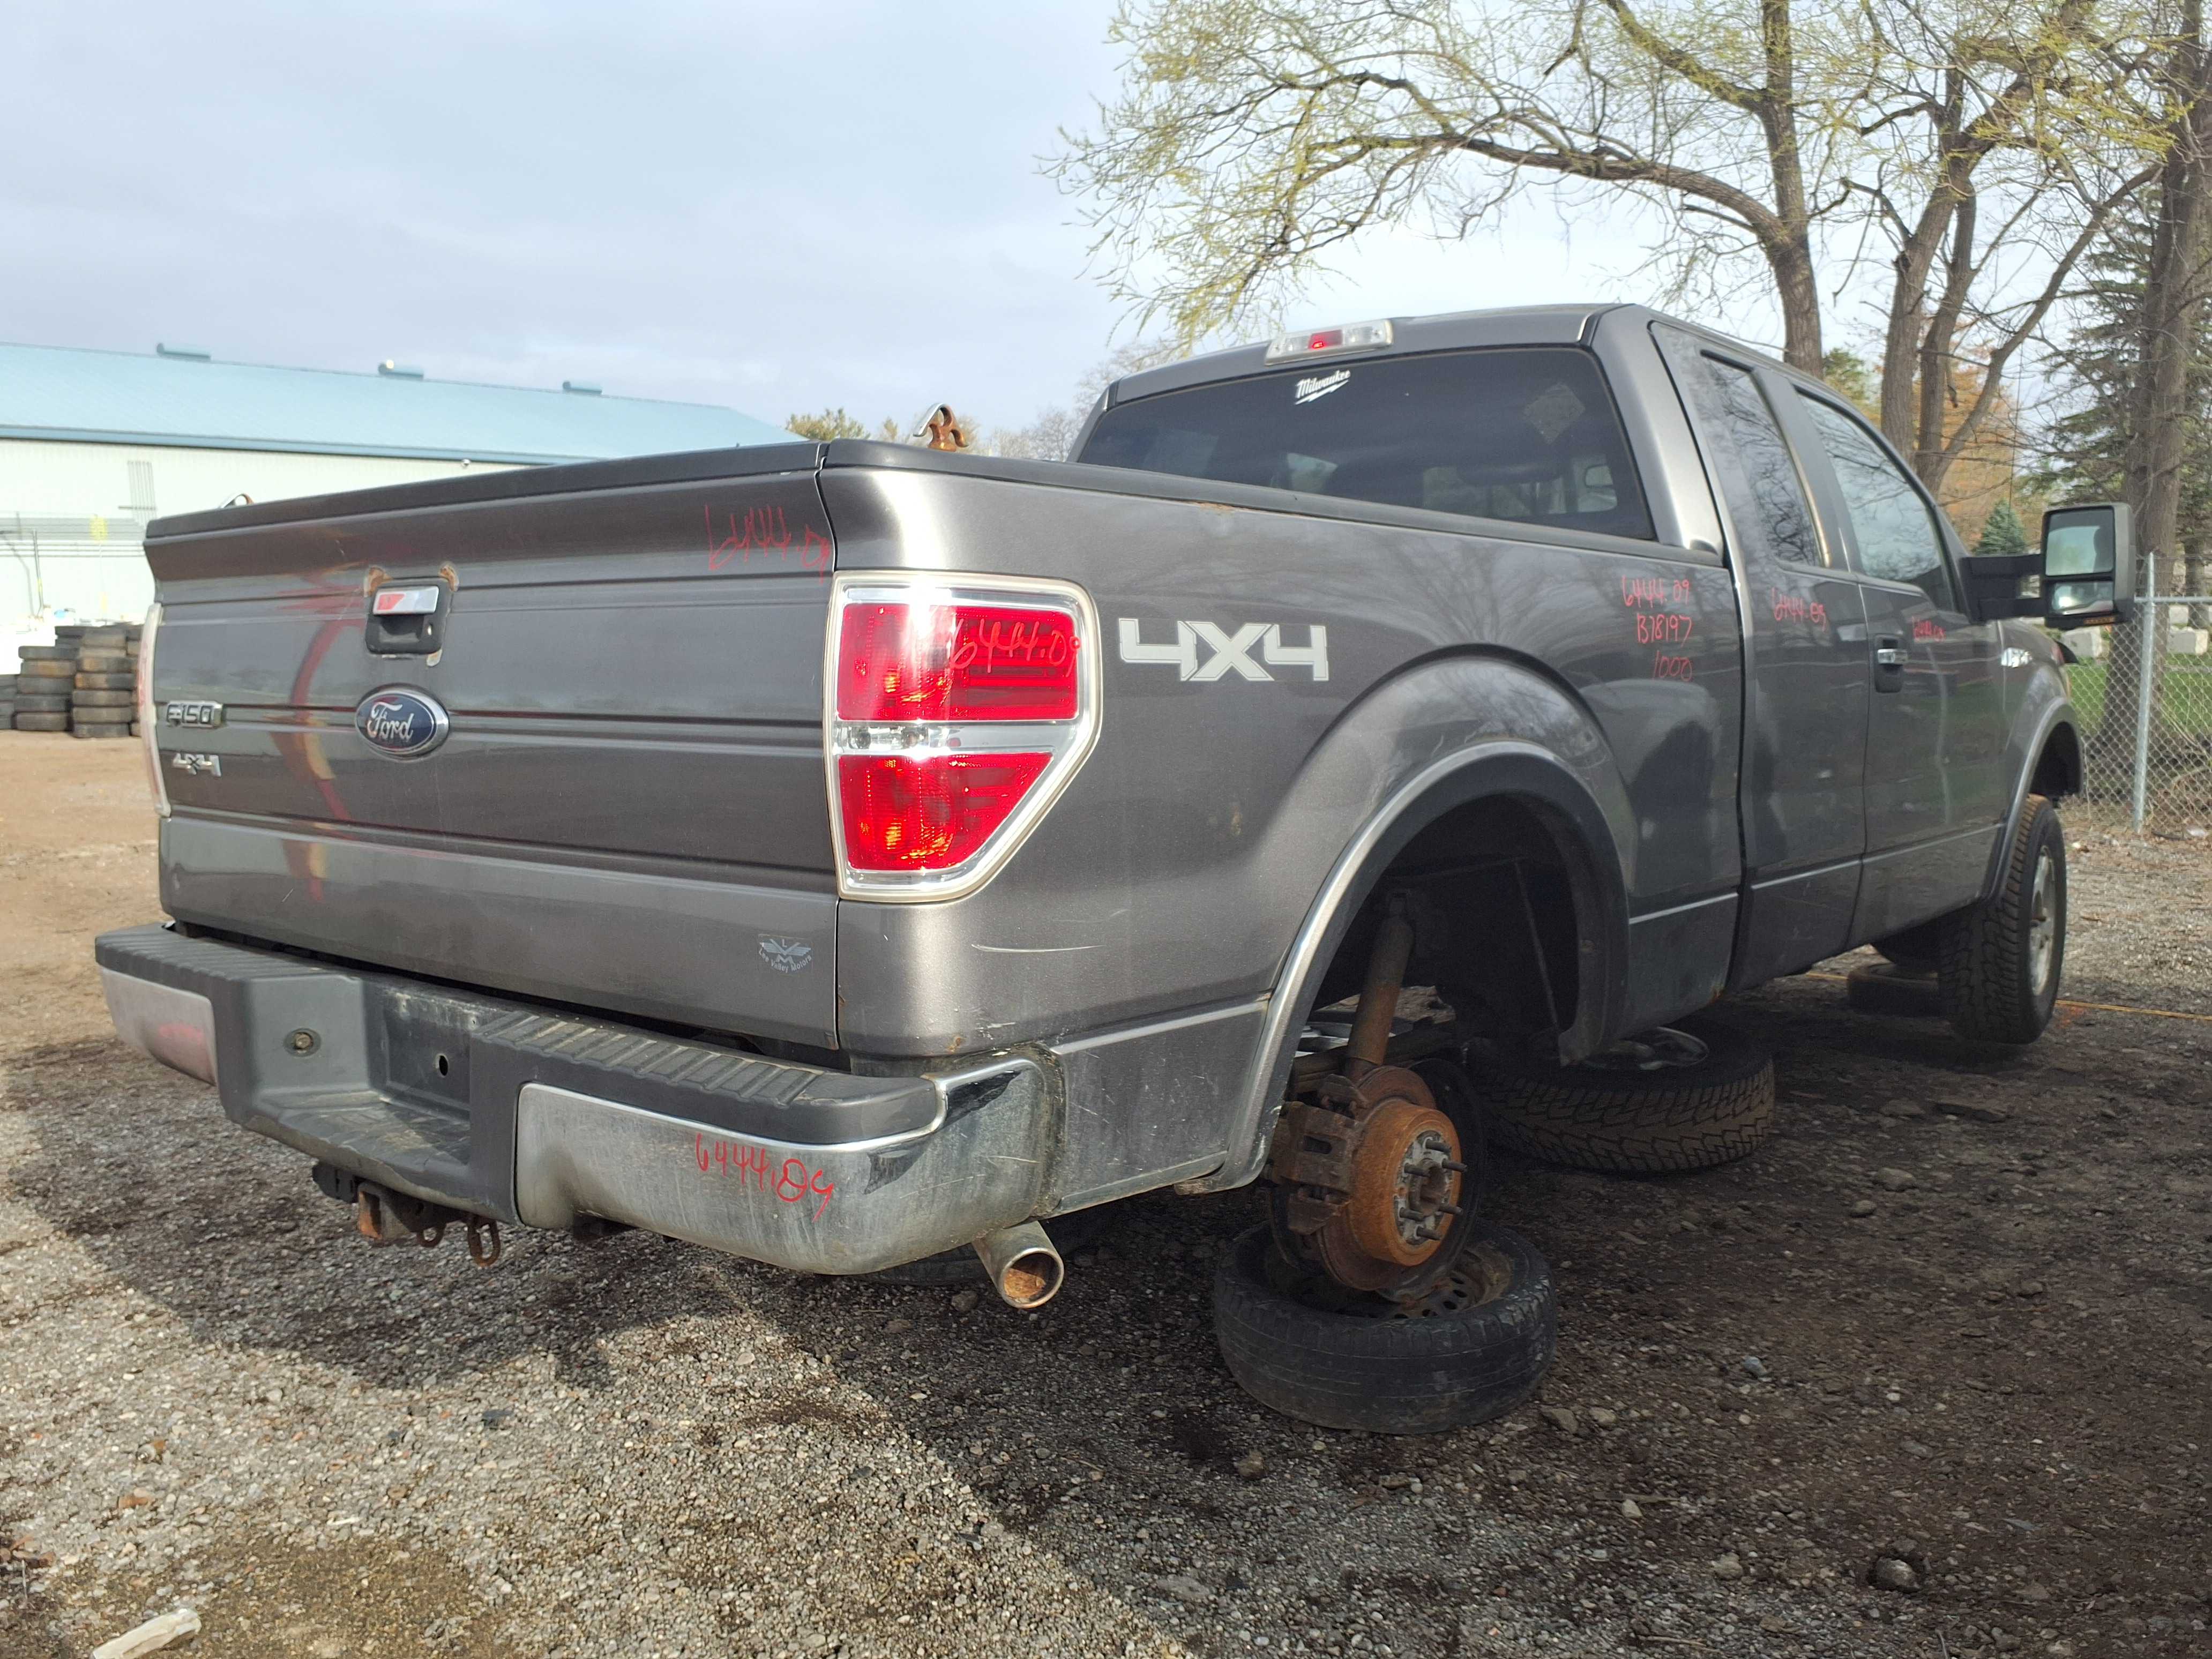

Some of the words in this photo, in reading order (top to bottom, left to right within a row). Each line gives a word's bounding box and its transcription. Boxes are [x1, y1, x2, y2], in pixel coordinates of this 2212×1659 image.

[1652, 649, 1692, 682] 1000
[367, 701, 415, 741] Ford
[771, 959, 789, 974] Valley
[791, 955, 812, 972] Motors
